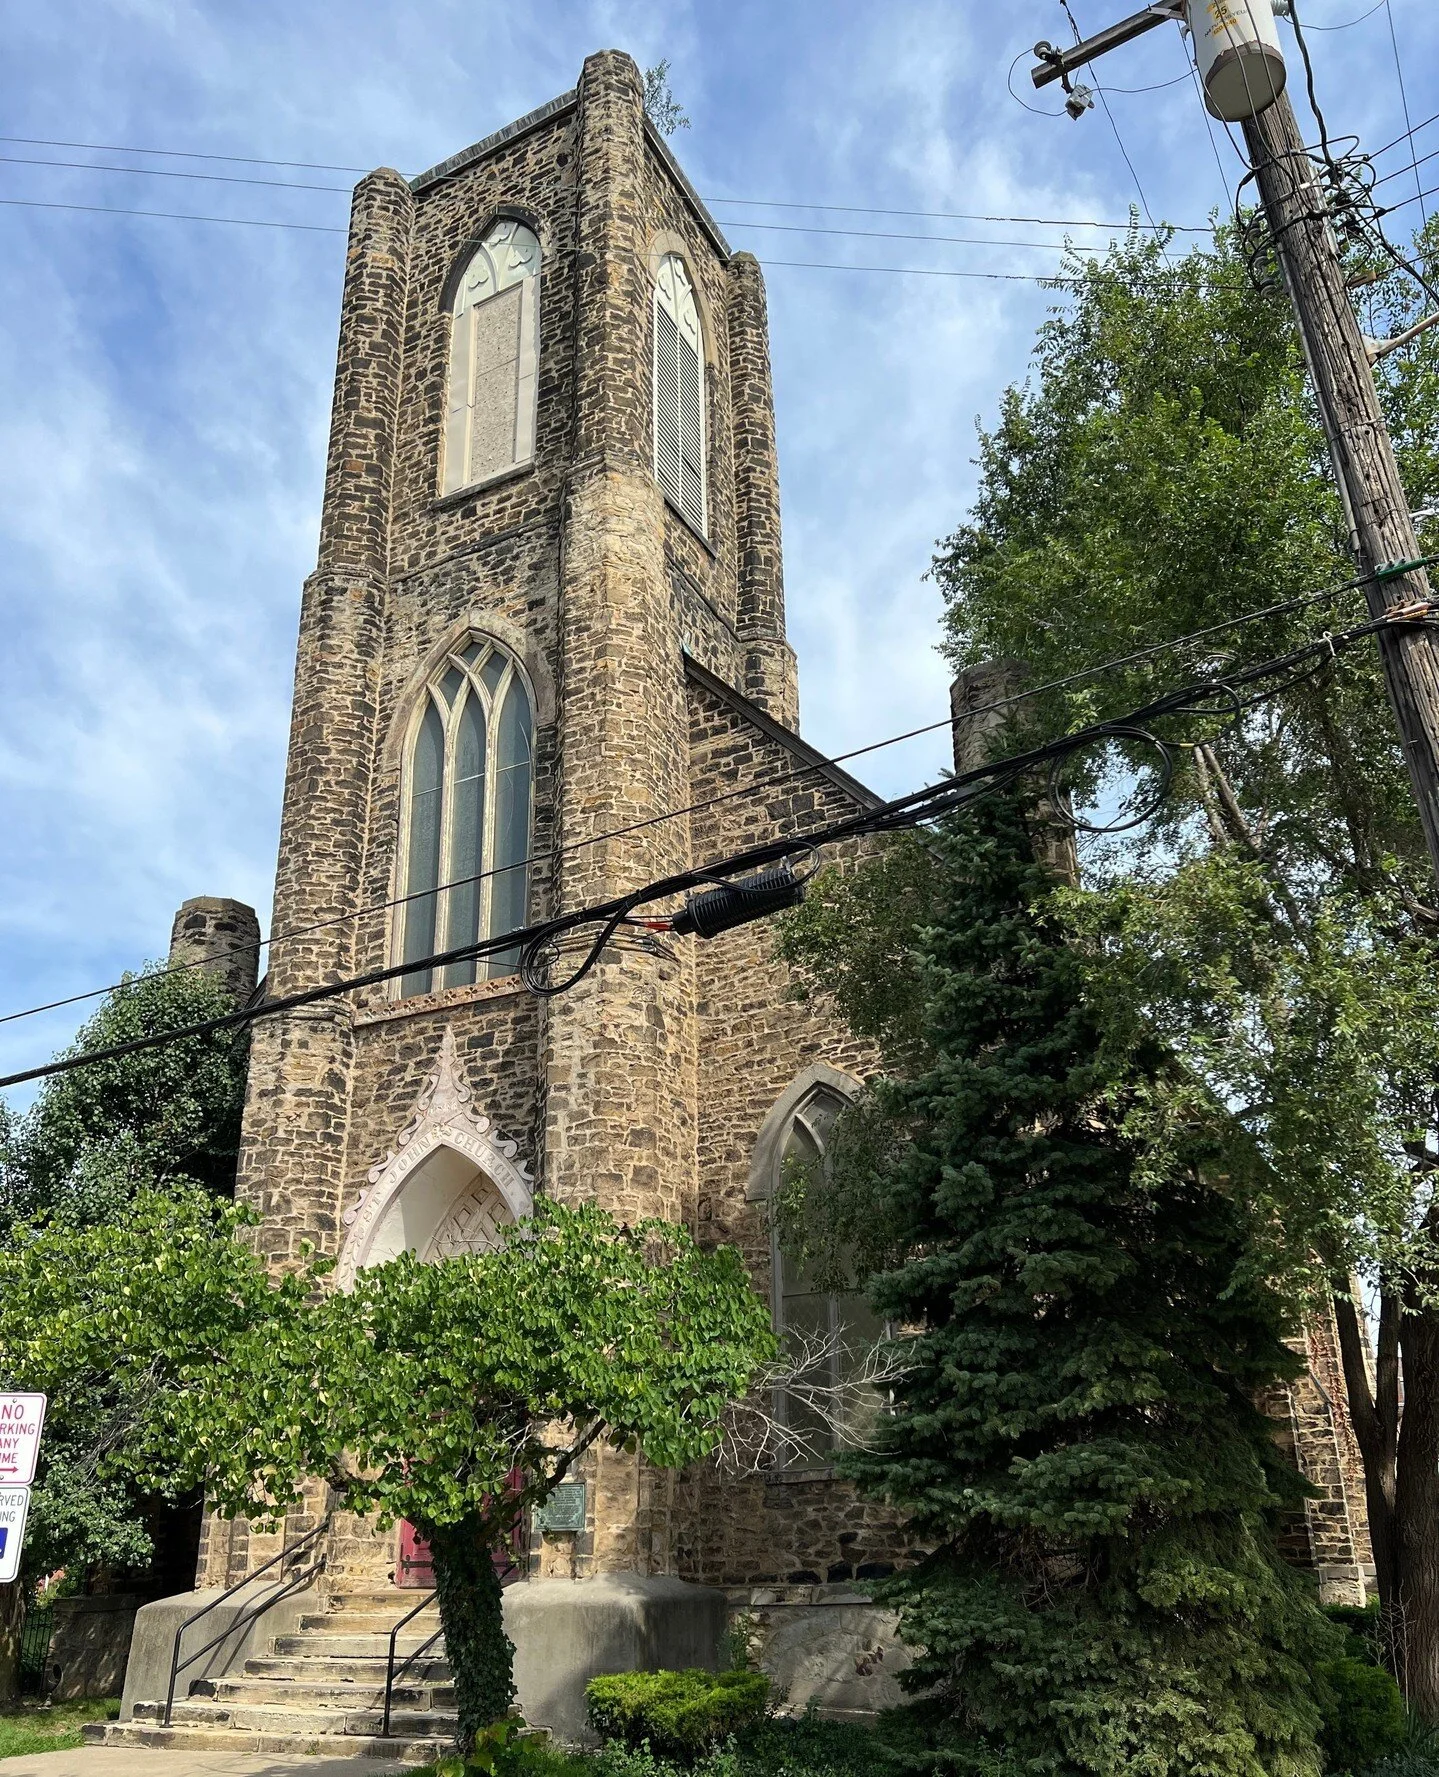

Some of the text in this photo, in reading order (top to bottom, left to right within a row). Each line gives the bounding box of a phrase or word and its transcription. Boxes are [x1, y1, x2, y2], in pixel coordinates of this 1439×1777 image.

[1214, 5, 1228, 19] 25
[454, 1132, 515, 1188] CHURCH
[1, 1404, 25, 1420] NO
